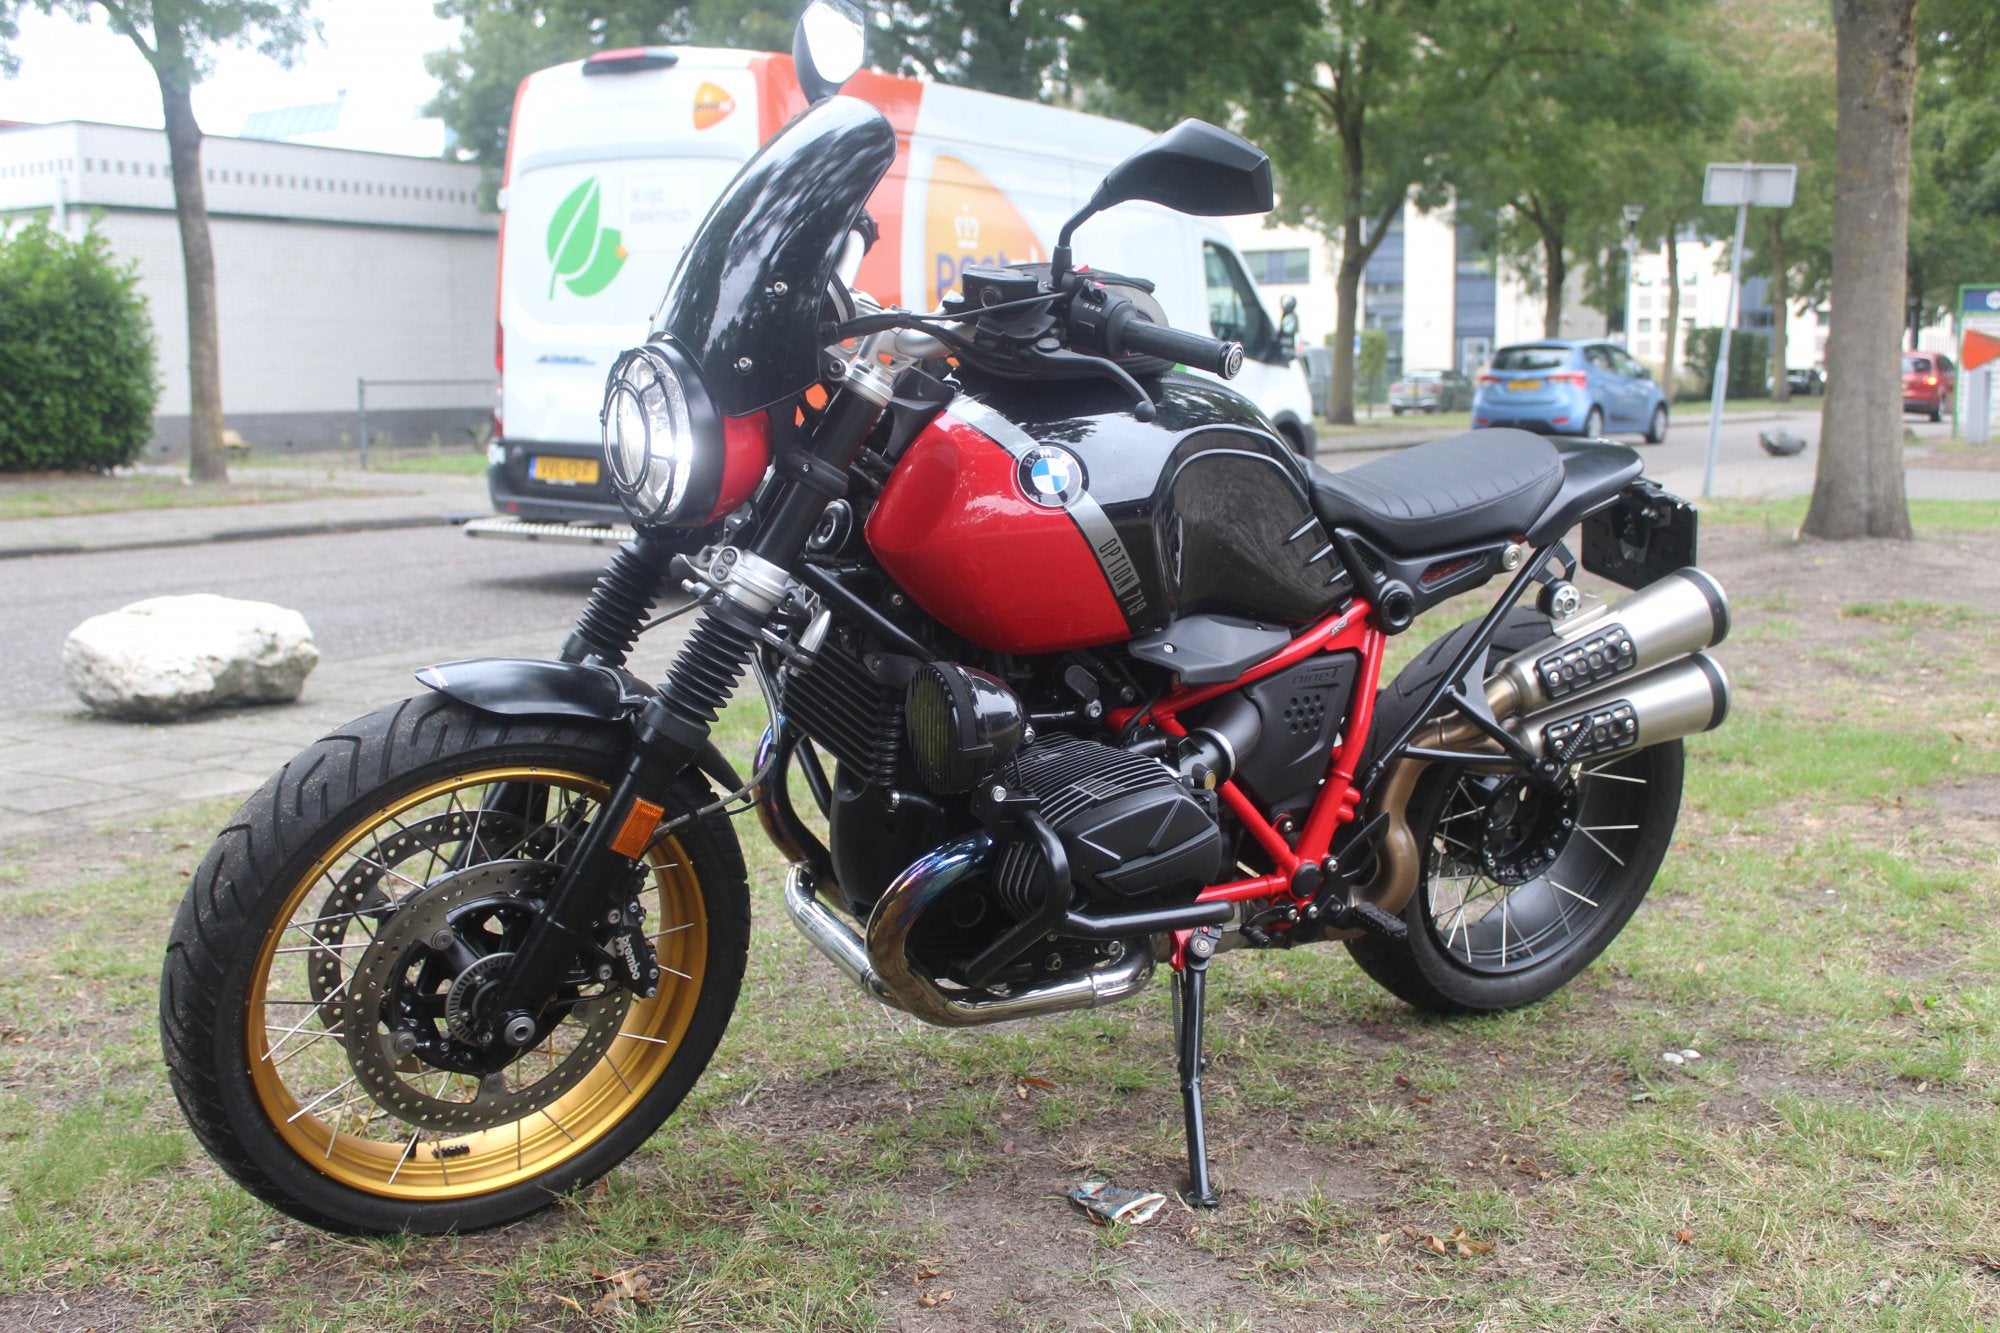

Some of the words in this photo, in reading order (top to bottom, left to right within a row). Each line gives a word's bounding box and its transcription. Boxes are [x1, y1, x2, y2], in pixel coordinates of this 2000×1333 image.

[1099, 537, 1136, 591] OPTION
[1122, 587, 1147, 617] 719
[622, 933, 640, 980] brembo
